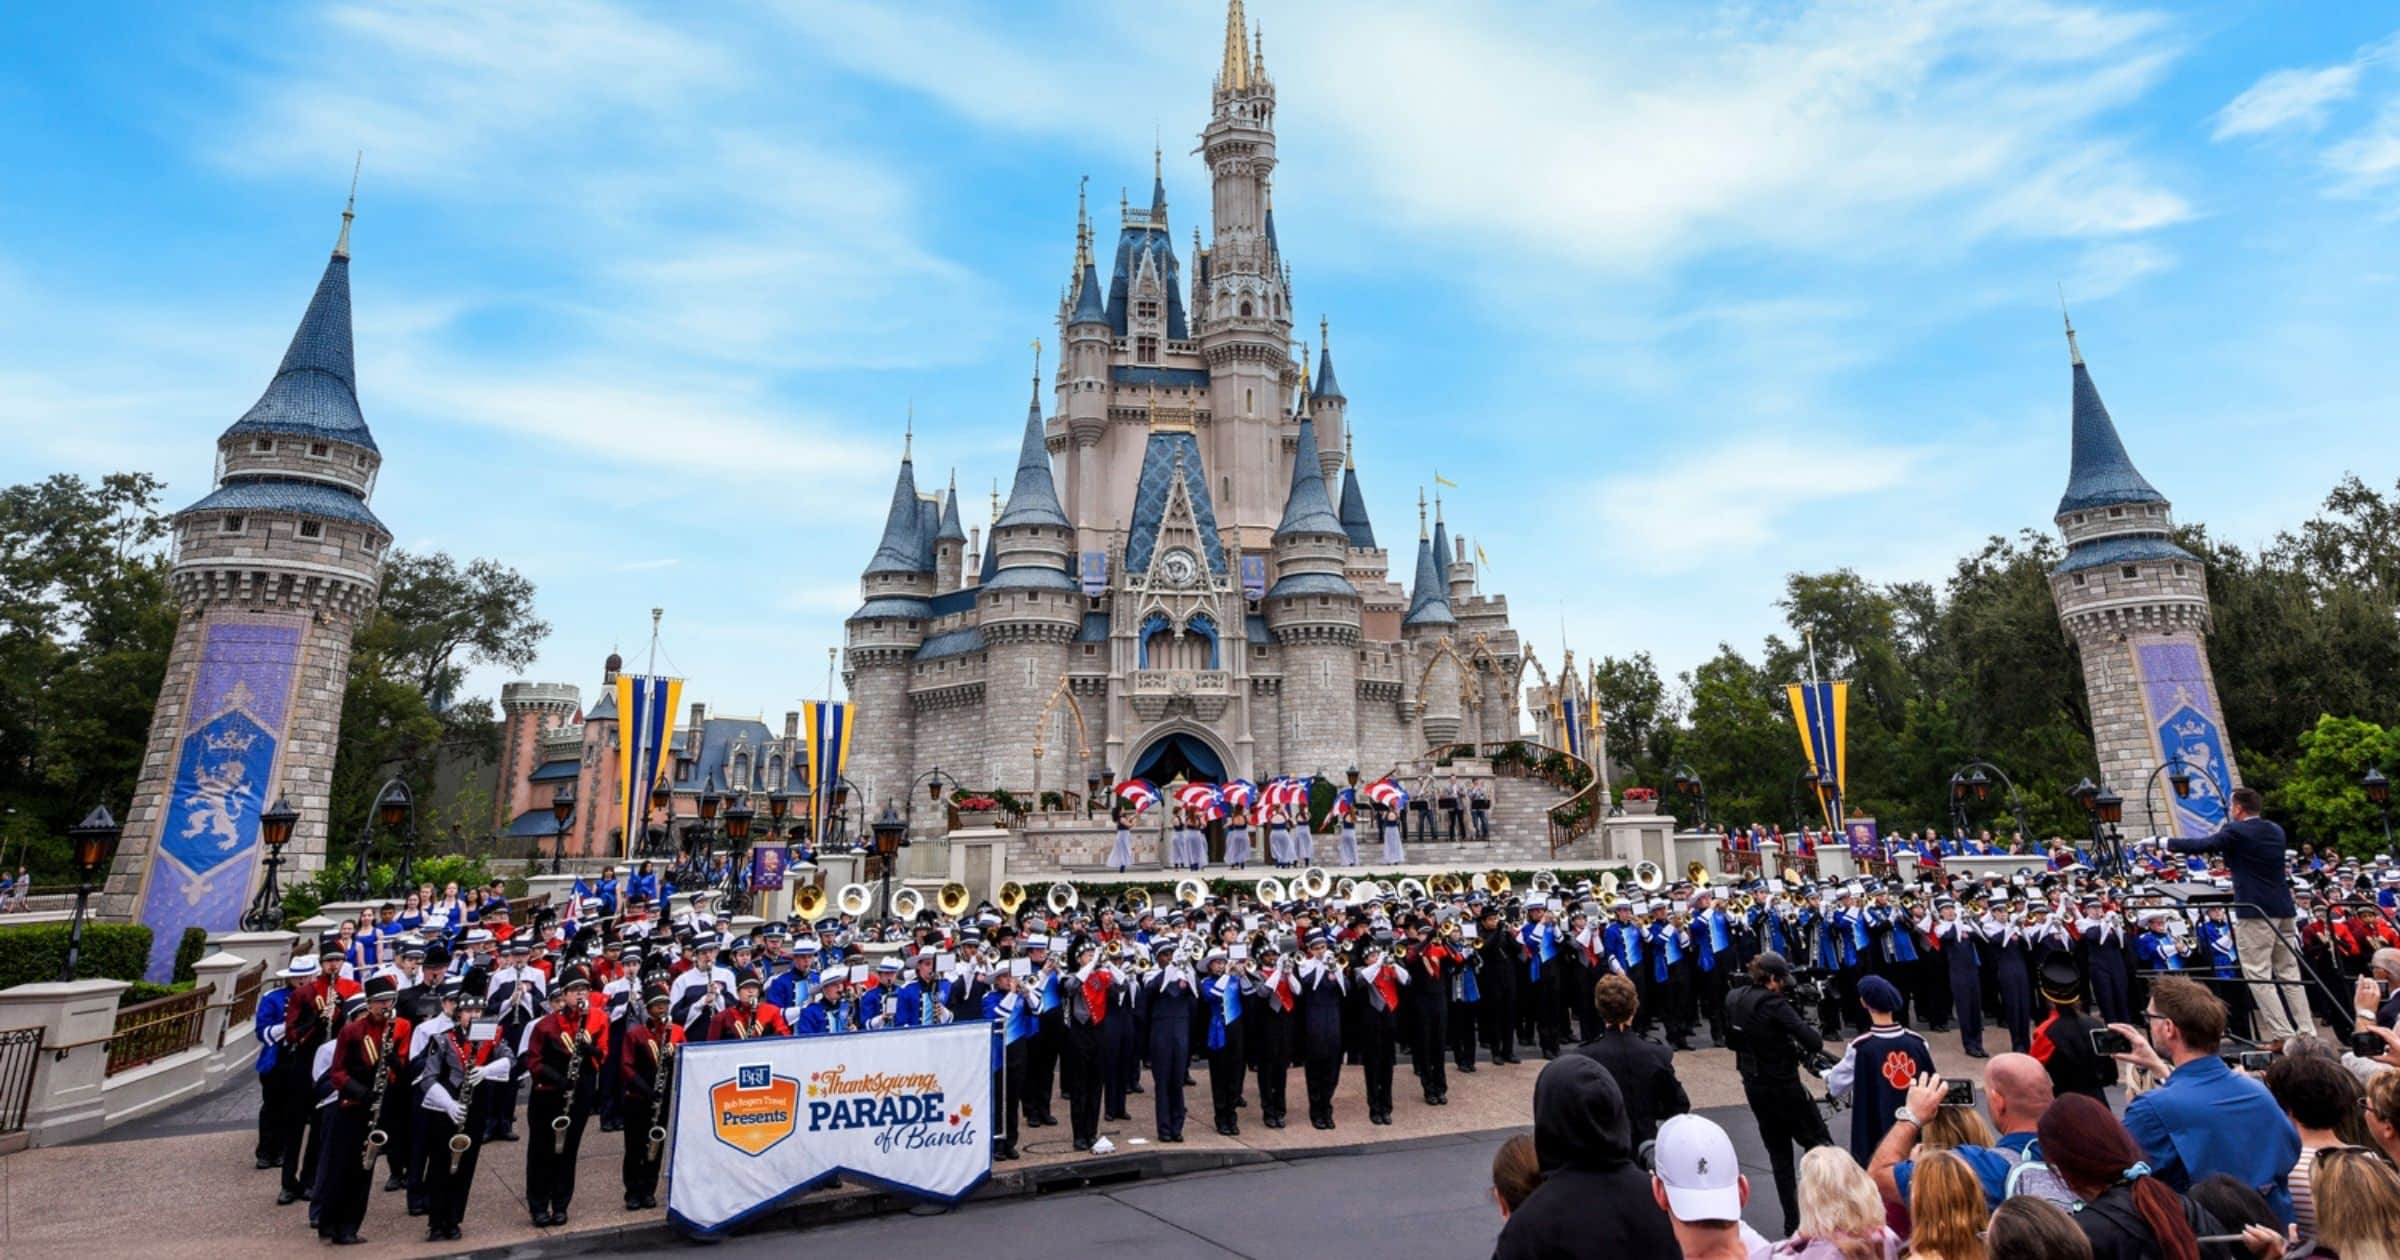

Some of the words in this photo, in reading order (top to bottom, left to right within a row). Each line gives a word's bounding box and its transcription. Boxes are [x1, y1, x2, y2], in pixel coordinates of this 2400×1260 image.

[820, 1064, 943, 1099] Thanksgiving
[722, 1109, 788, 1126] Presents
[808, 1092, 945, 1131] PARADE
[874, 1125, 893, 1154] of
[894, 1120, 977, 1150] Bands
